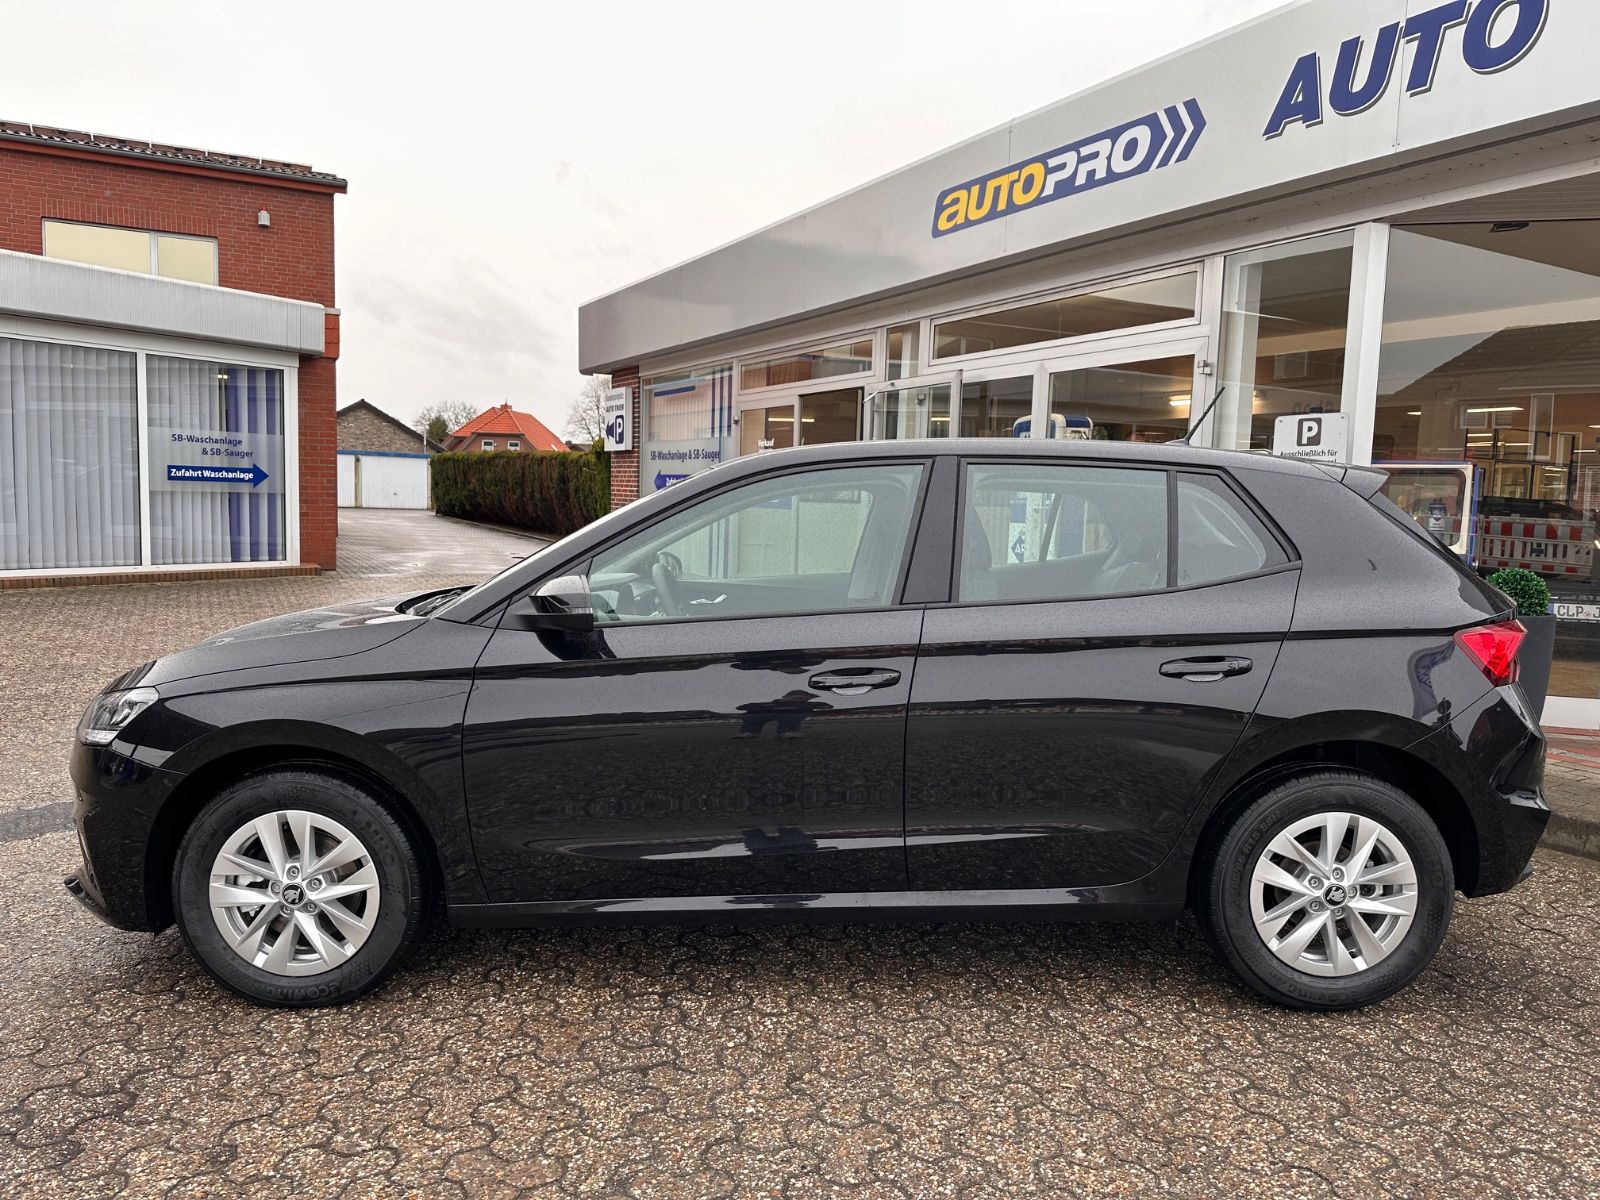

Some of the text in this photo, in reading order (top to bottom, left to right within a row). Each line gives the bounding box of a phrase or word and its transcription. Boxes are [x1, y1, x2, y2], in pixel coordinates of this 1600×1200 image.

[1261, 0, 1550, 141] AUTO
[1301, 421, 1319, 444] P
[171, 433, 243, 447] SB-Waschanlage
[201, 448, 254, 459] & SB-Sauger
[650, 450, 688, 463] SB-Waschanlage
[1327, 449, 1338, 457] für
[170, 469, 254, 480] Zufahrt Waschanlage
[1557, 604, 1584, 618] CLP
